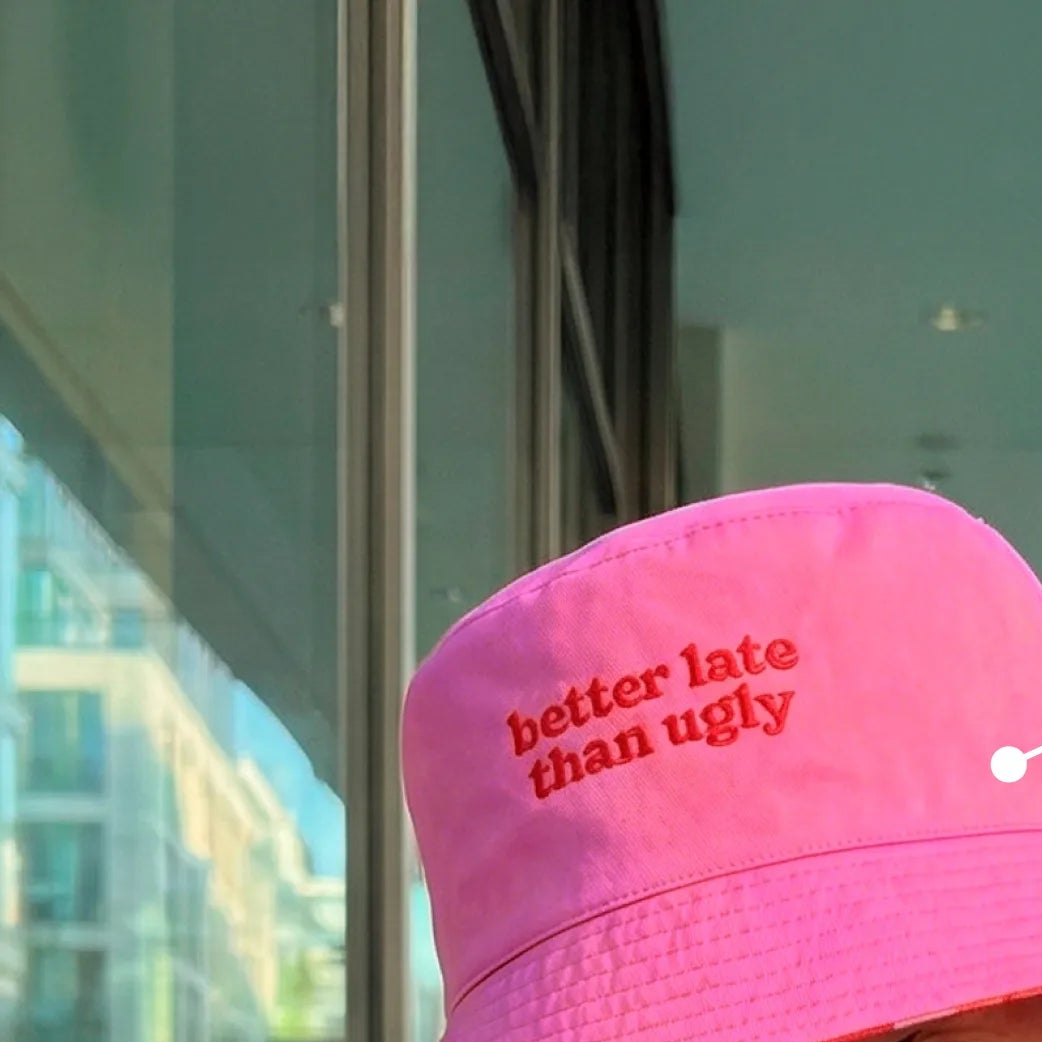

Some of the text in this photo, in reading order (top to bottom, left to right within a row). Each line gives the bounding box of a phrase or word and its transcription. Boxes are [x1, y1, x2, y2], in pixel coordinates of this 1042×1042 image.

[506, 633, 799, 756] better late
[528, 682, 795, 799] than ugly
